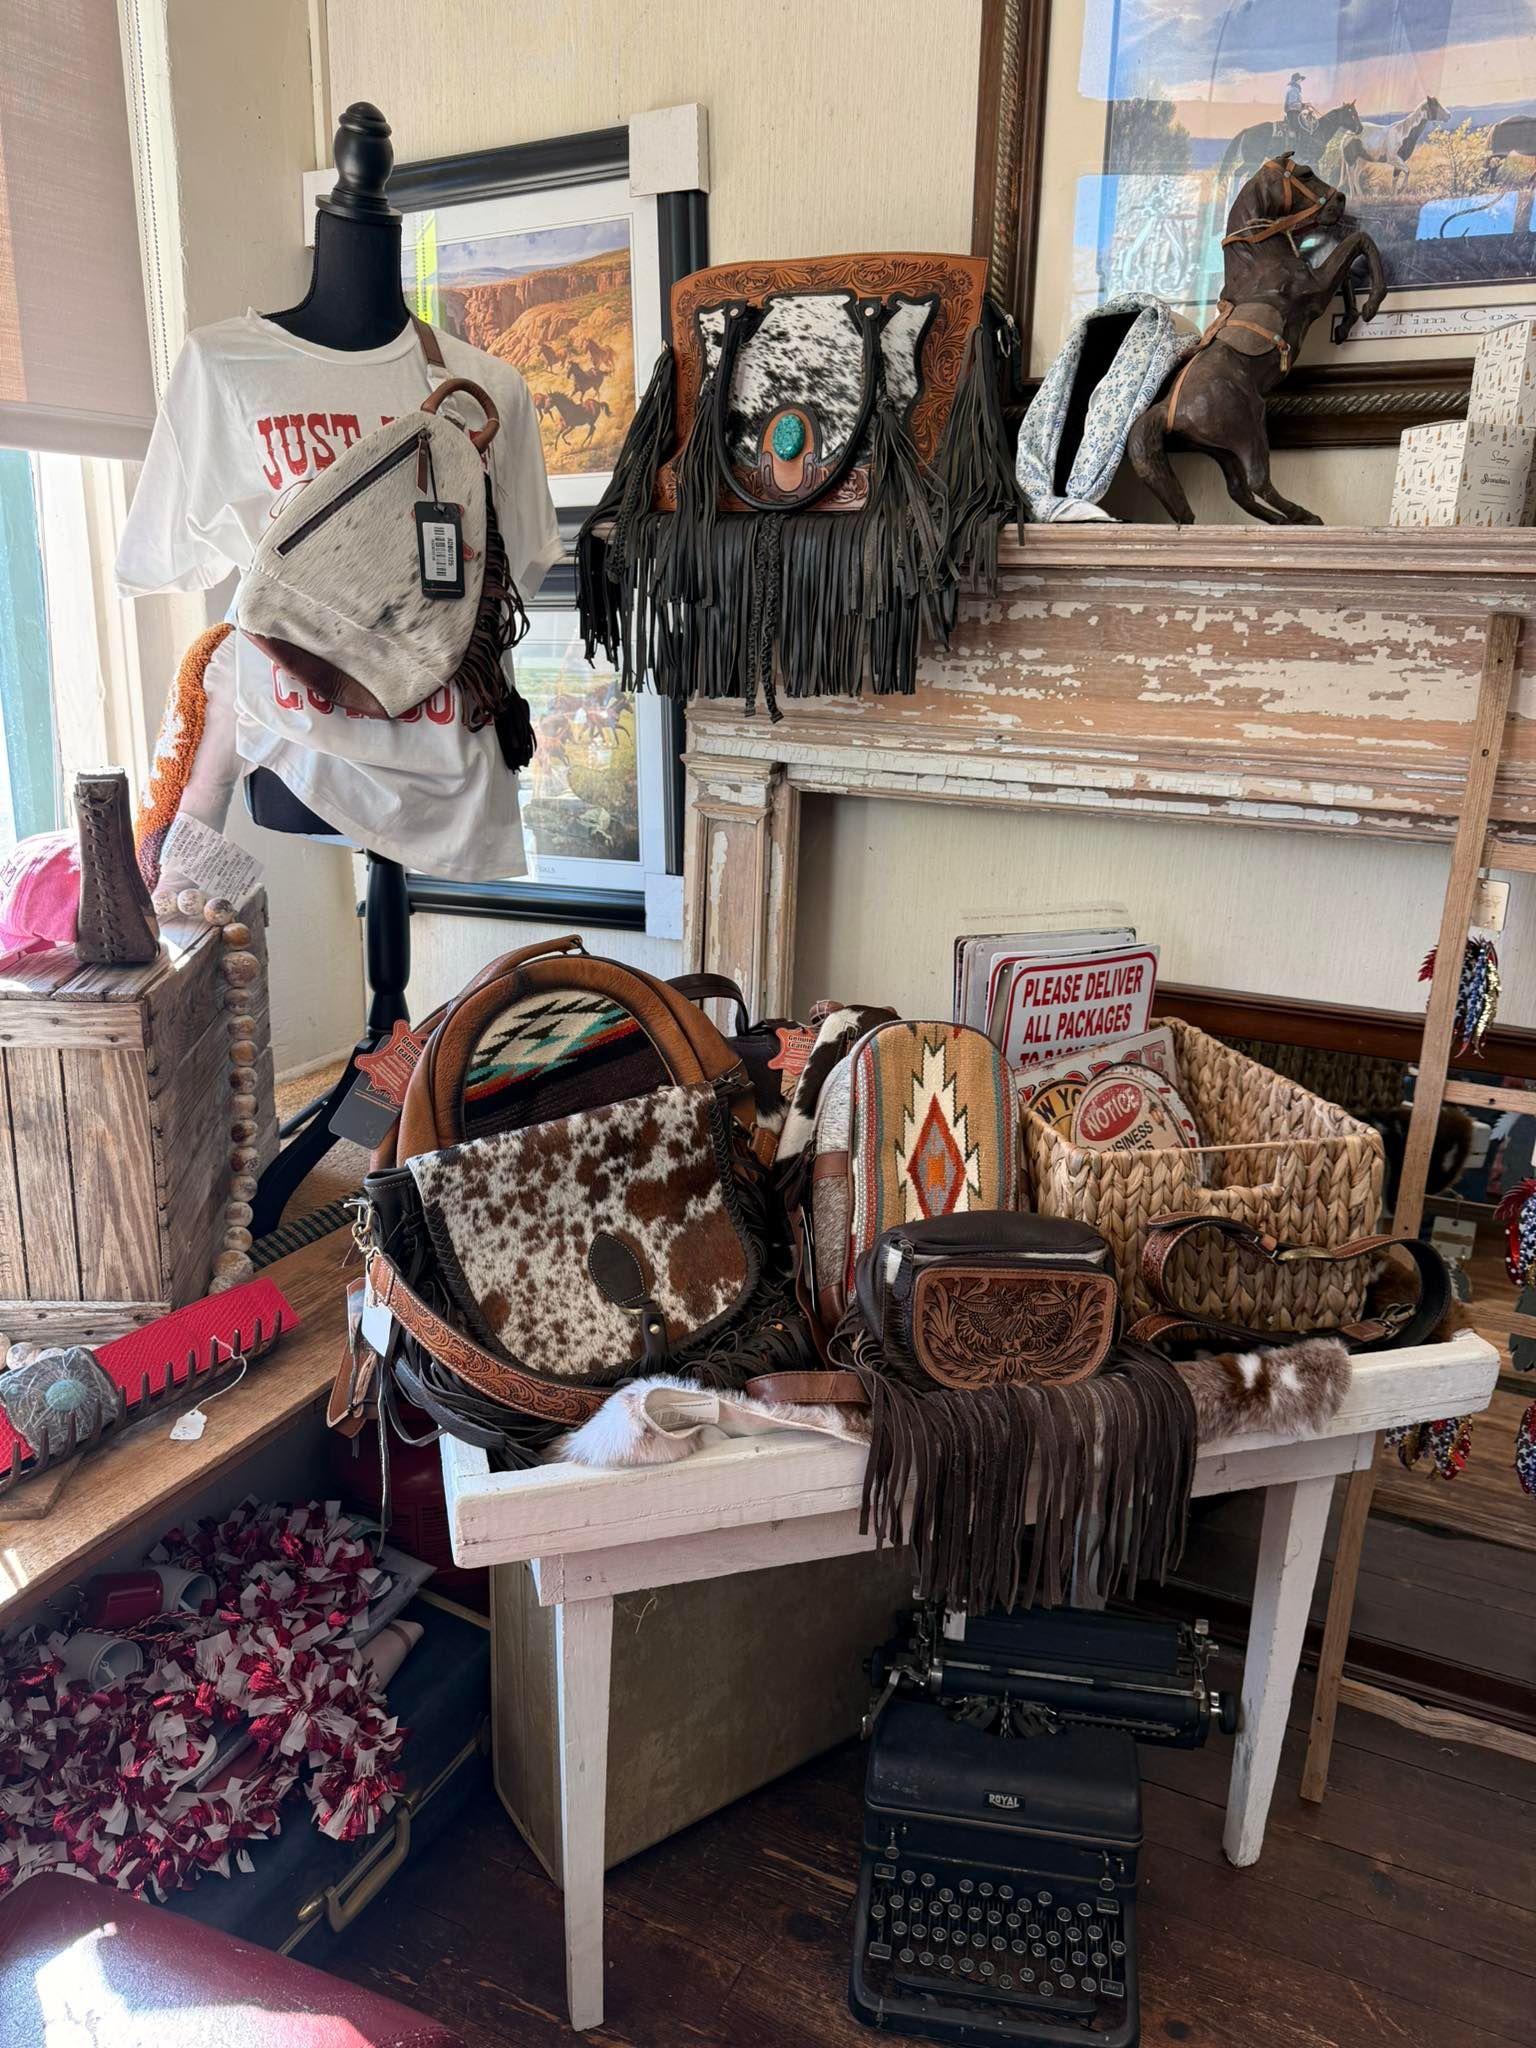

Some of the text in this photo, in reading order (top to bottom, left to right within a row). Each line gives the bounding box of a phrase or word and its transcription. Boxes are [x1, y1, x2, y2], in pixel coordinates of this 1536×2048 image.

[1386, 308, 1519, 327] Tim Cox
[1350, 328, 1408, 338] ETWEEN
[1414, 325, 1473, 336] HEAVEN
[257, 413, 361, 490] JUST
[1022, 964, 1144, 1008] PLEASE DELIVER
[1022, 1002, 1133, 1045] ALL PACKAGES
[394, 1044, 418, 1068] Leathe
[401, 1036, 421, 1056] Genui
[1084, 1087, 1140, 1137] NOTICE
[1101, 1121, 1154, 1152] USINESS
[989, 1793, 1020, 1809] ROYAL
